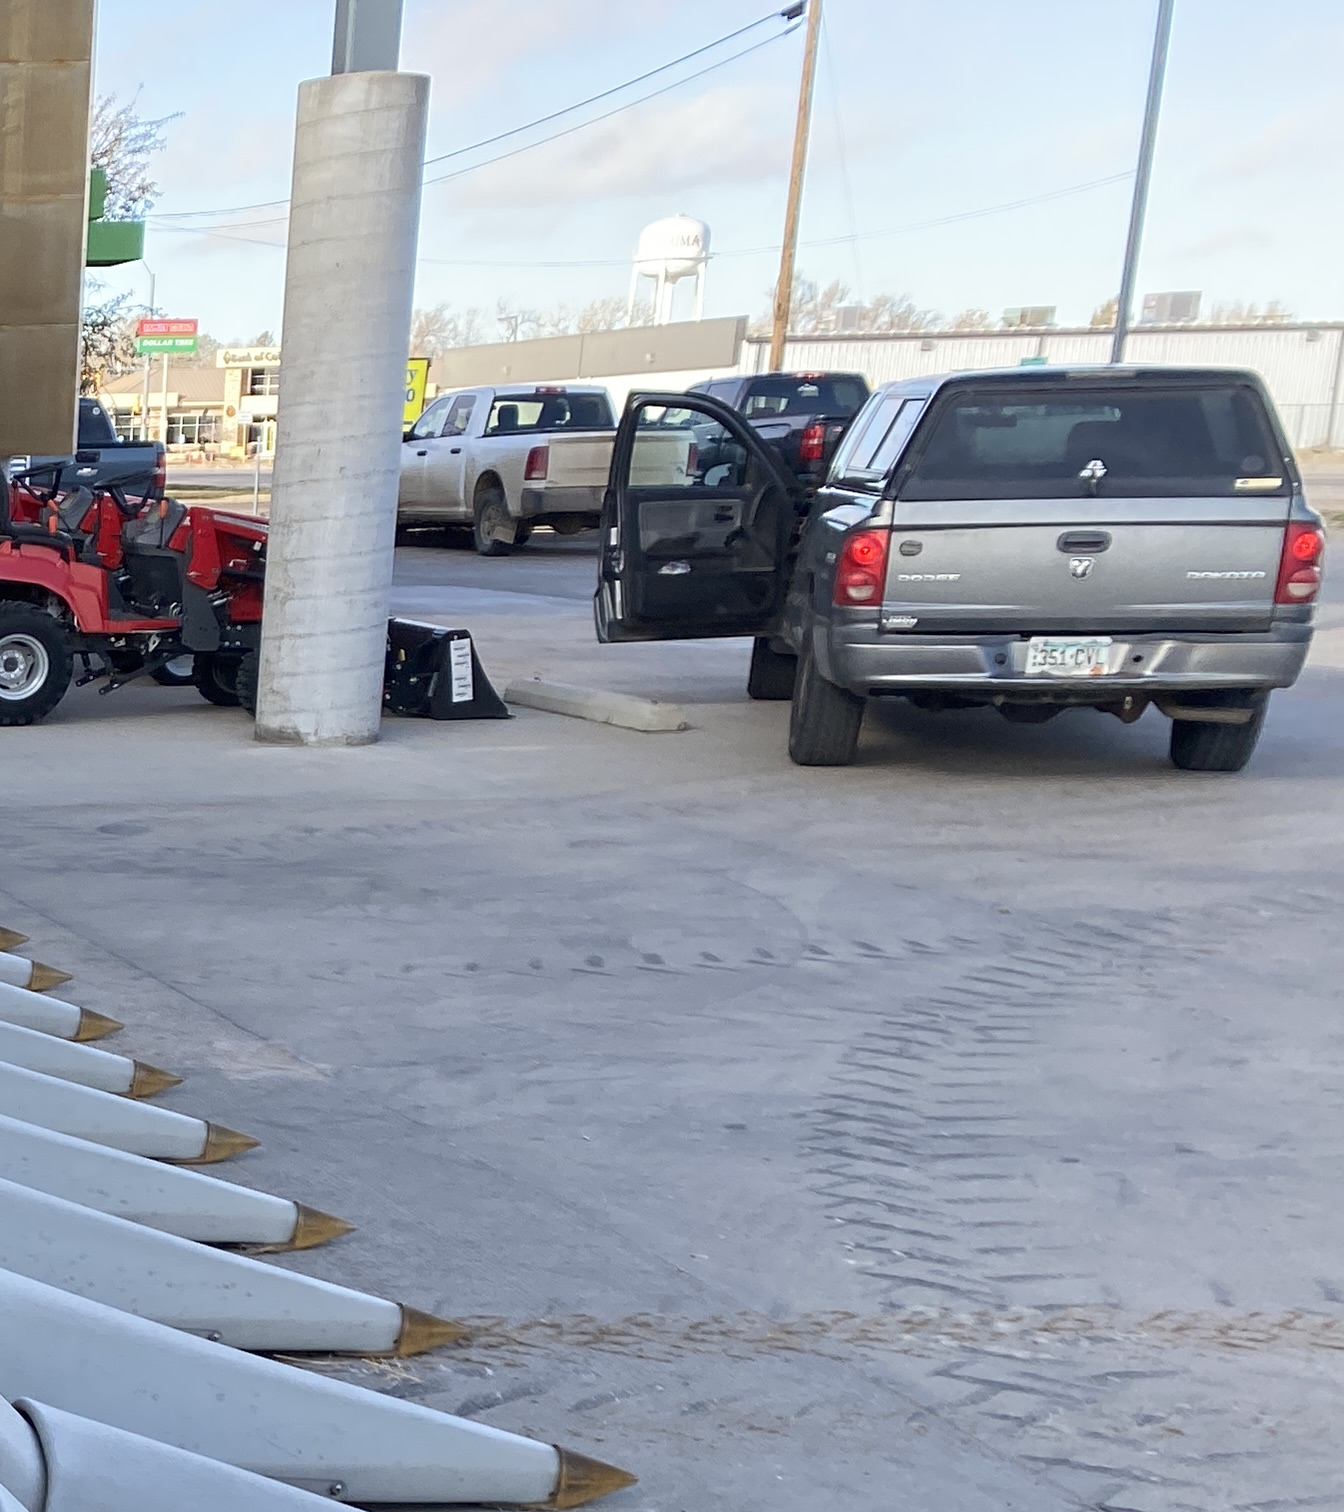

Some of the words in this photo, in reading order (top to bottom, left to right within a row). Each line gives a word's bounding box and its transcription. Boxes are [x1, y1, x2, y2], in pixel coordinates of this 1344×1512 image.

[142, 338, 174, 347] DOLLAR
[897, 572, 961, 582] DODGE
[1186, 570, 1267, 580] DAKOTA
